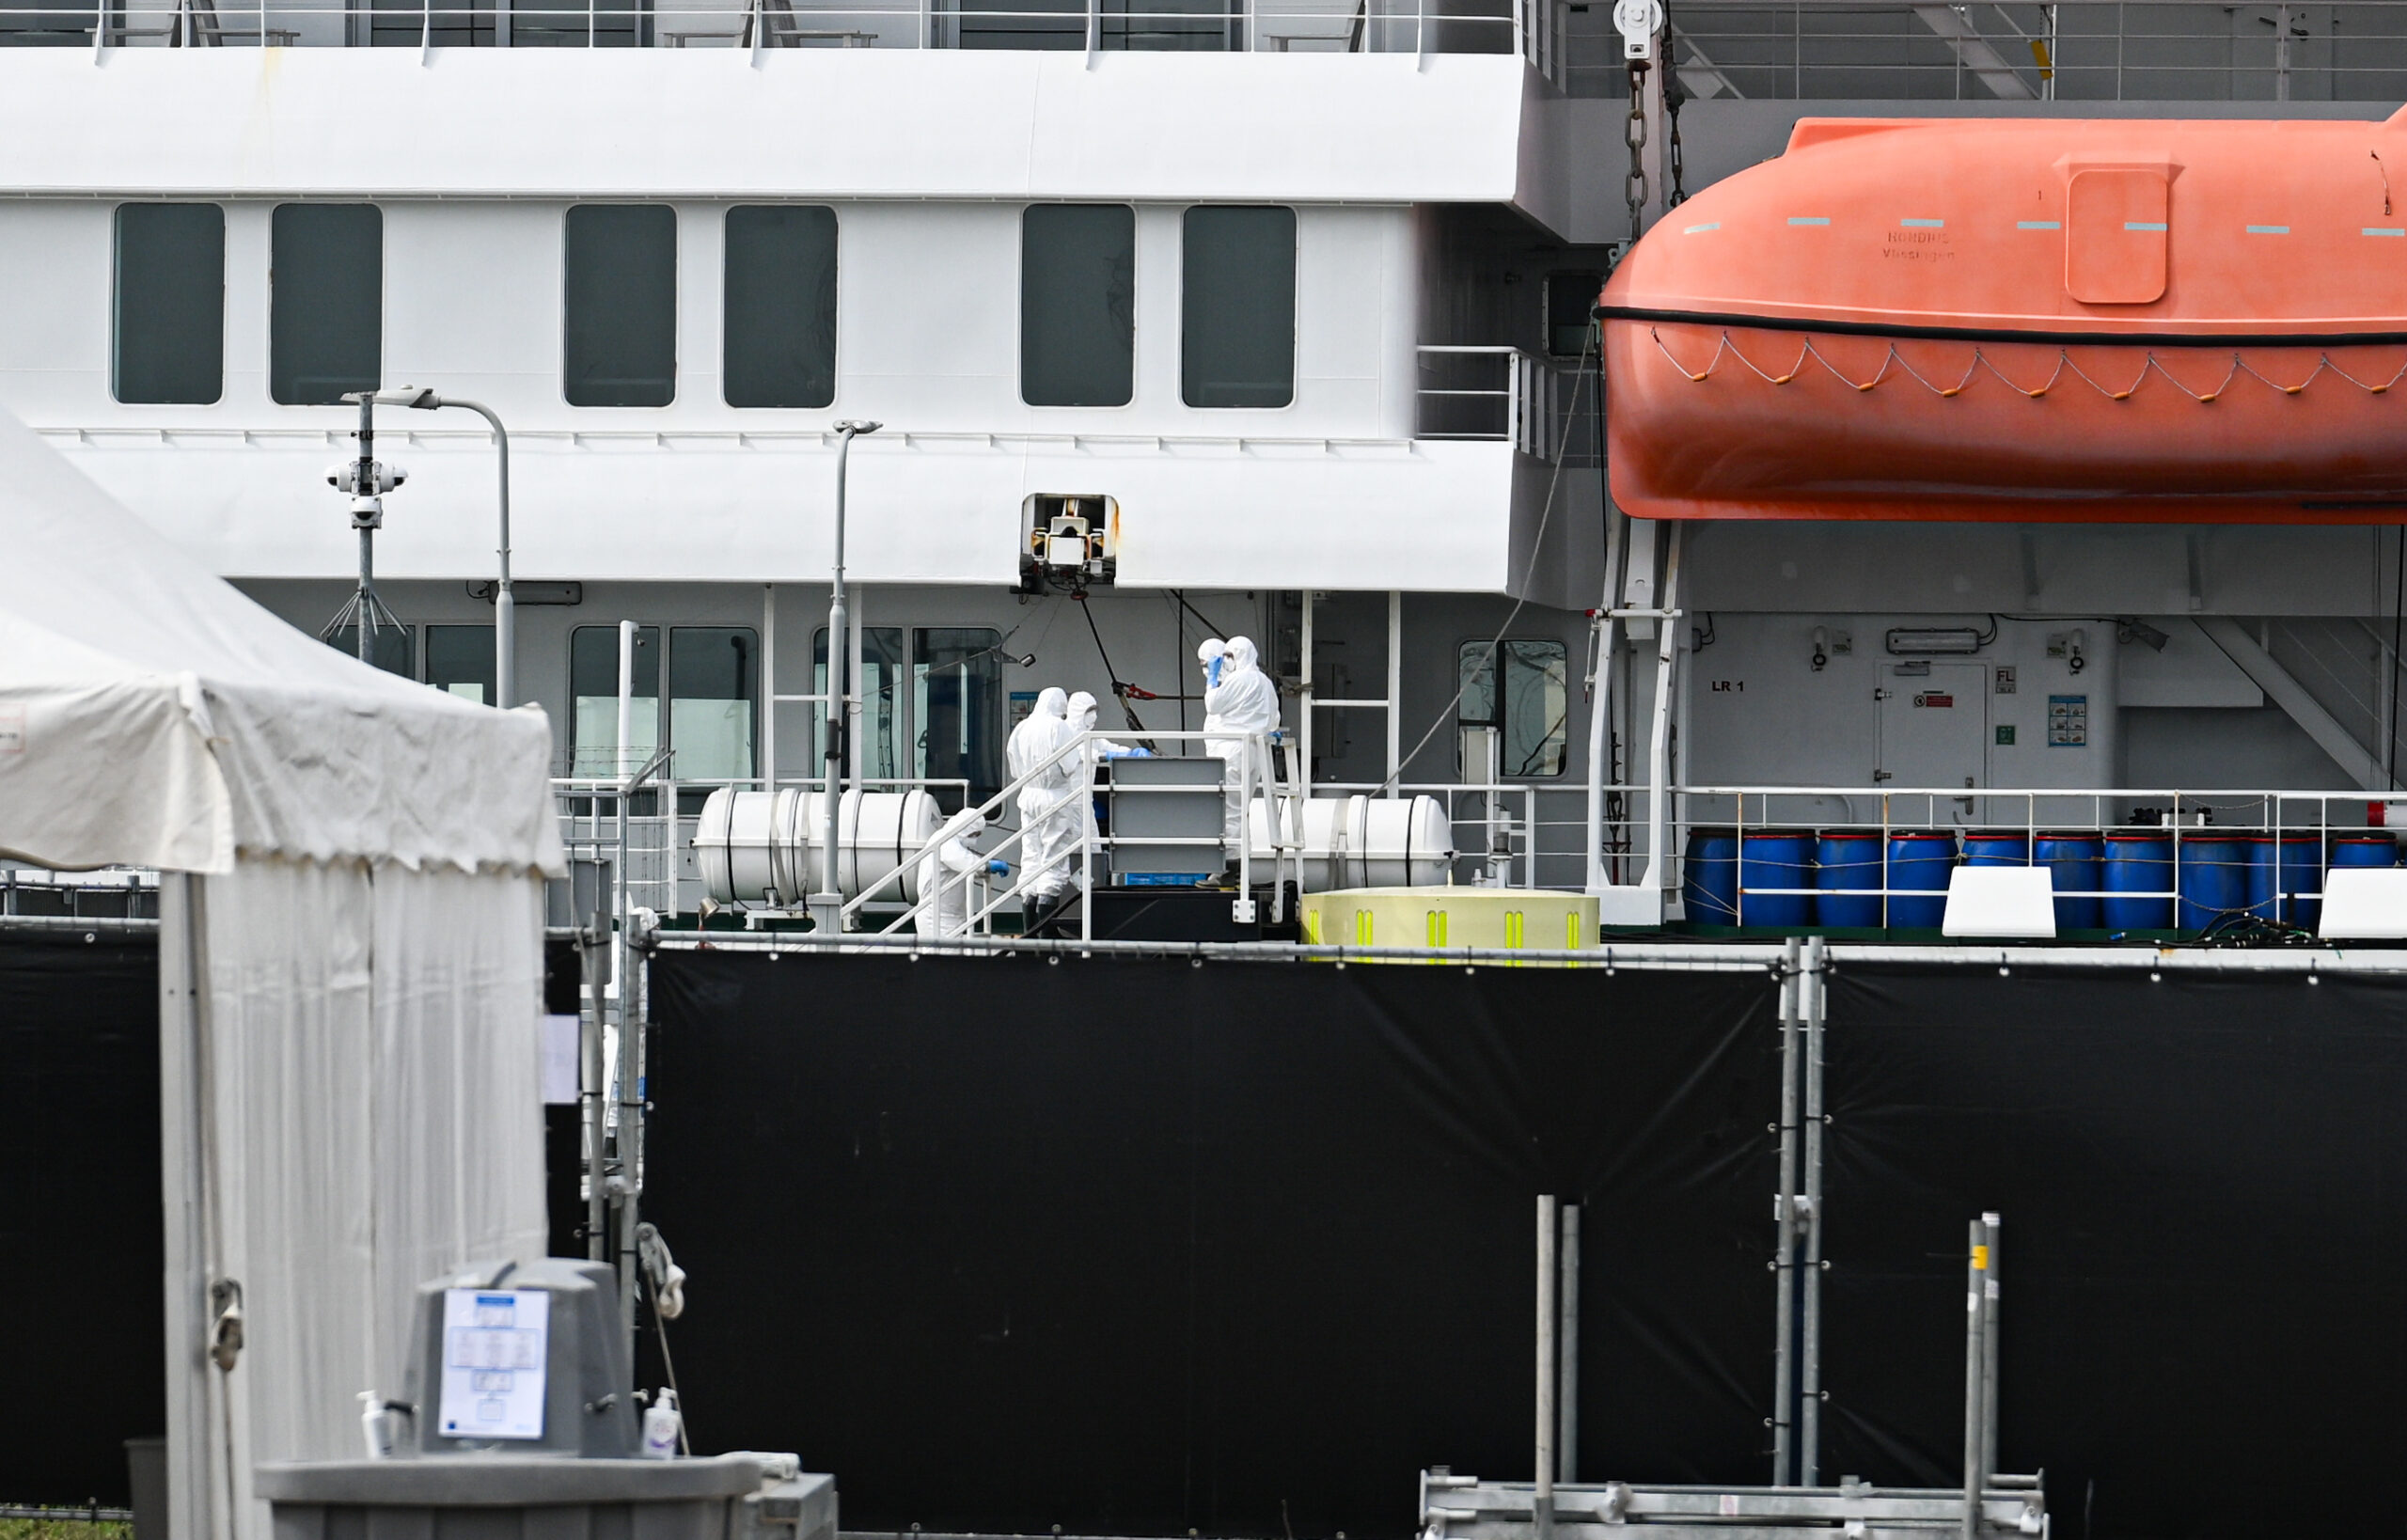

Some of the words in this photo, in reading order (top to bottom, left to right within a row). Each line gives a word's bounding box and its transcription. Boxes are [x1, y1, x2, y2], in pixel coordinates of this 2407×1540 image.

[1997, 669, 2015, 683] FL
[1712, 681, 1731, 692] LR
[1737, 681, 1744, 692] 1
